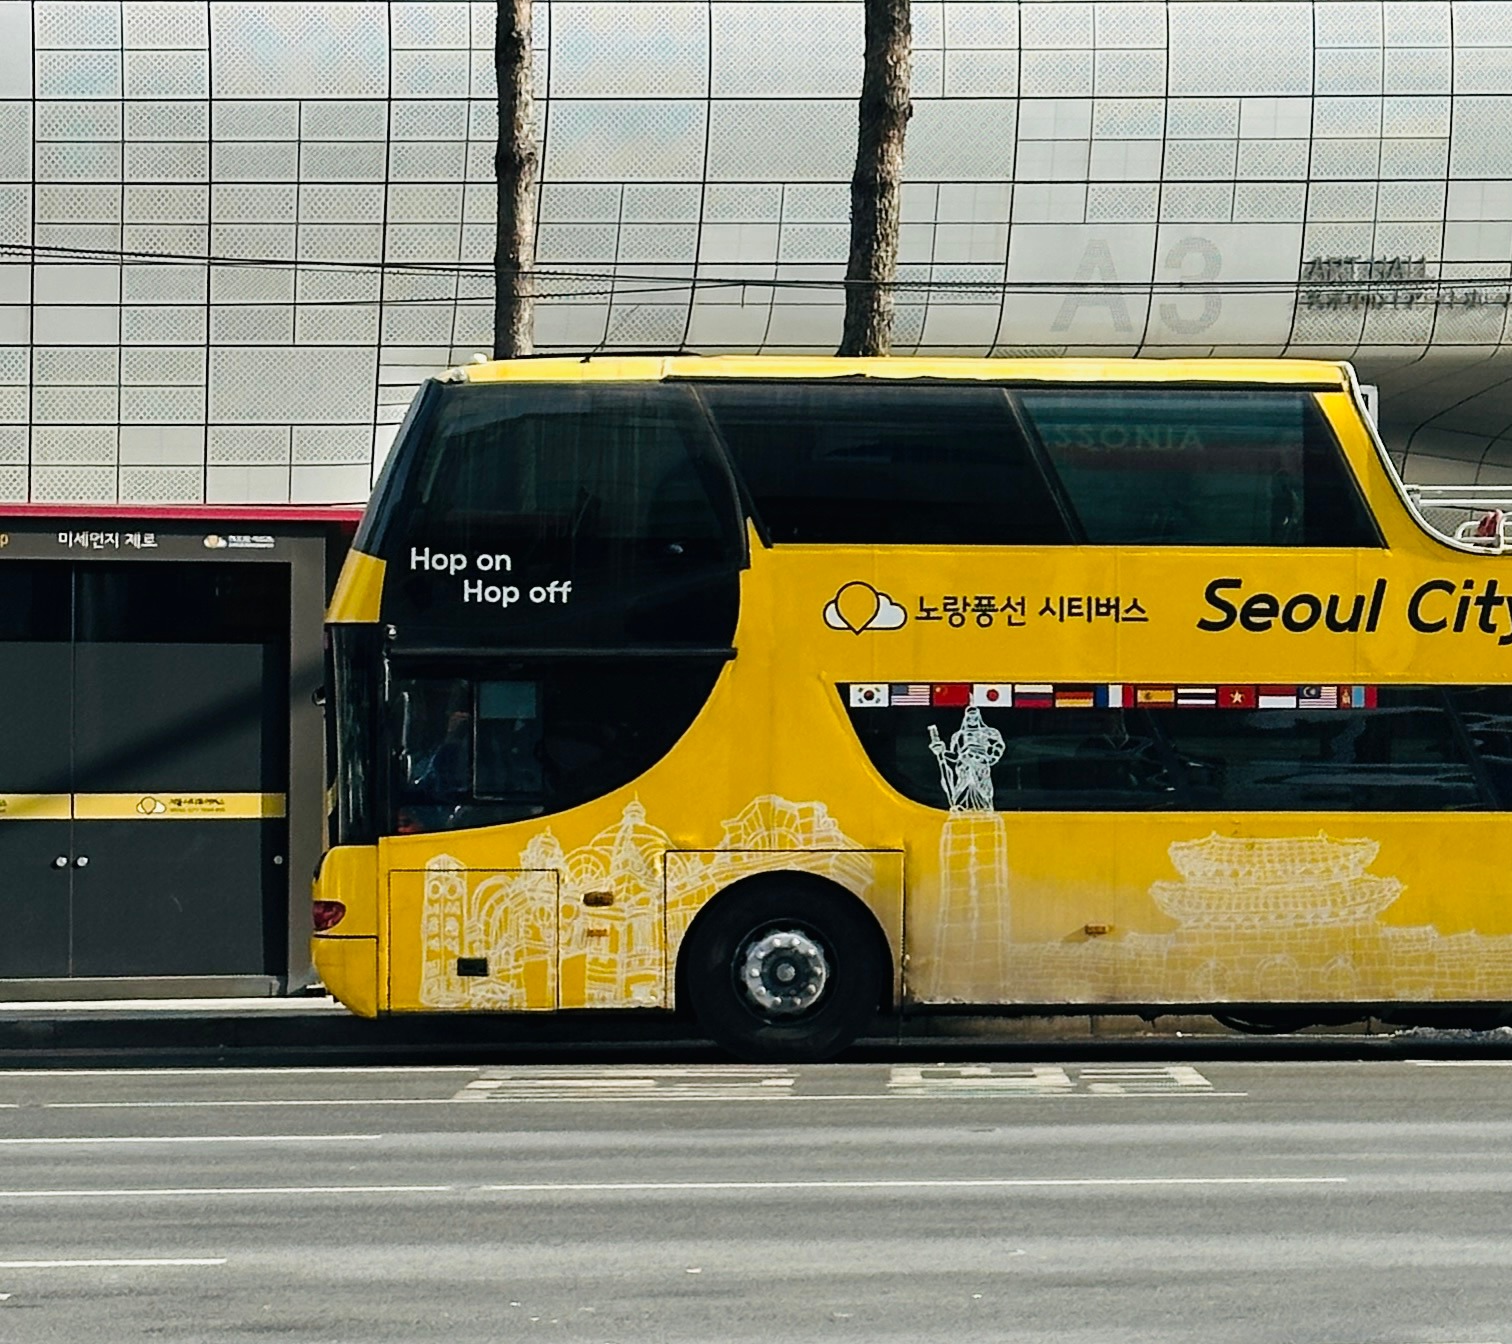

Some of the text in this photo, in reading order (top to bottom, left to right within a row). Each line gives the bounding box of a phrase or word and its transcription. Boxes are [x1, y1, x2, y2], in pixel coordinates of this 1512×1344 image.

[1050, 236, 1223, 335] A3
[124, 532, 158, 549] 제로
[410, 546, 512, 576] Hop on
[463, 579, 572, 608] Hop off
[1197, 577, 1386, 634] Seoul
[915, 595, 1149, 628] 노랑풍선 시티버스
